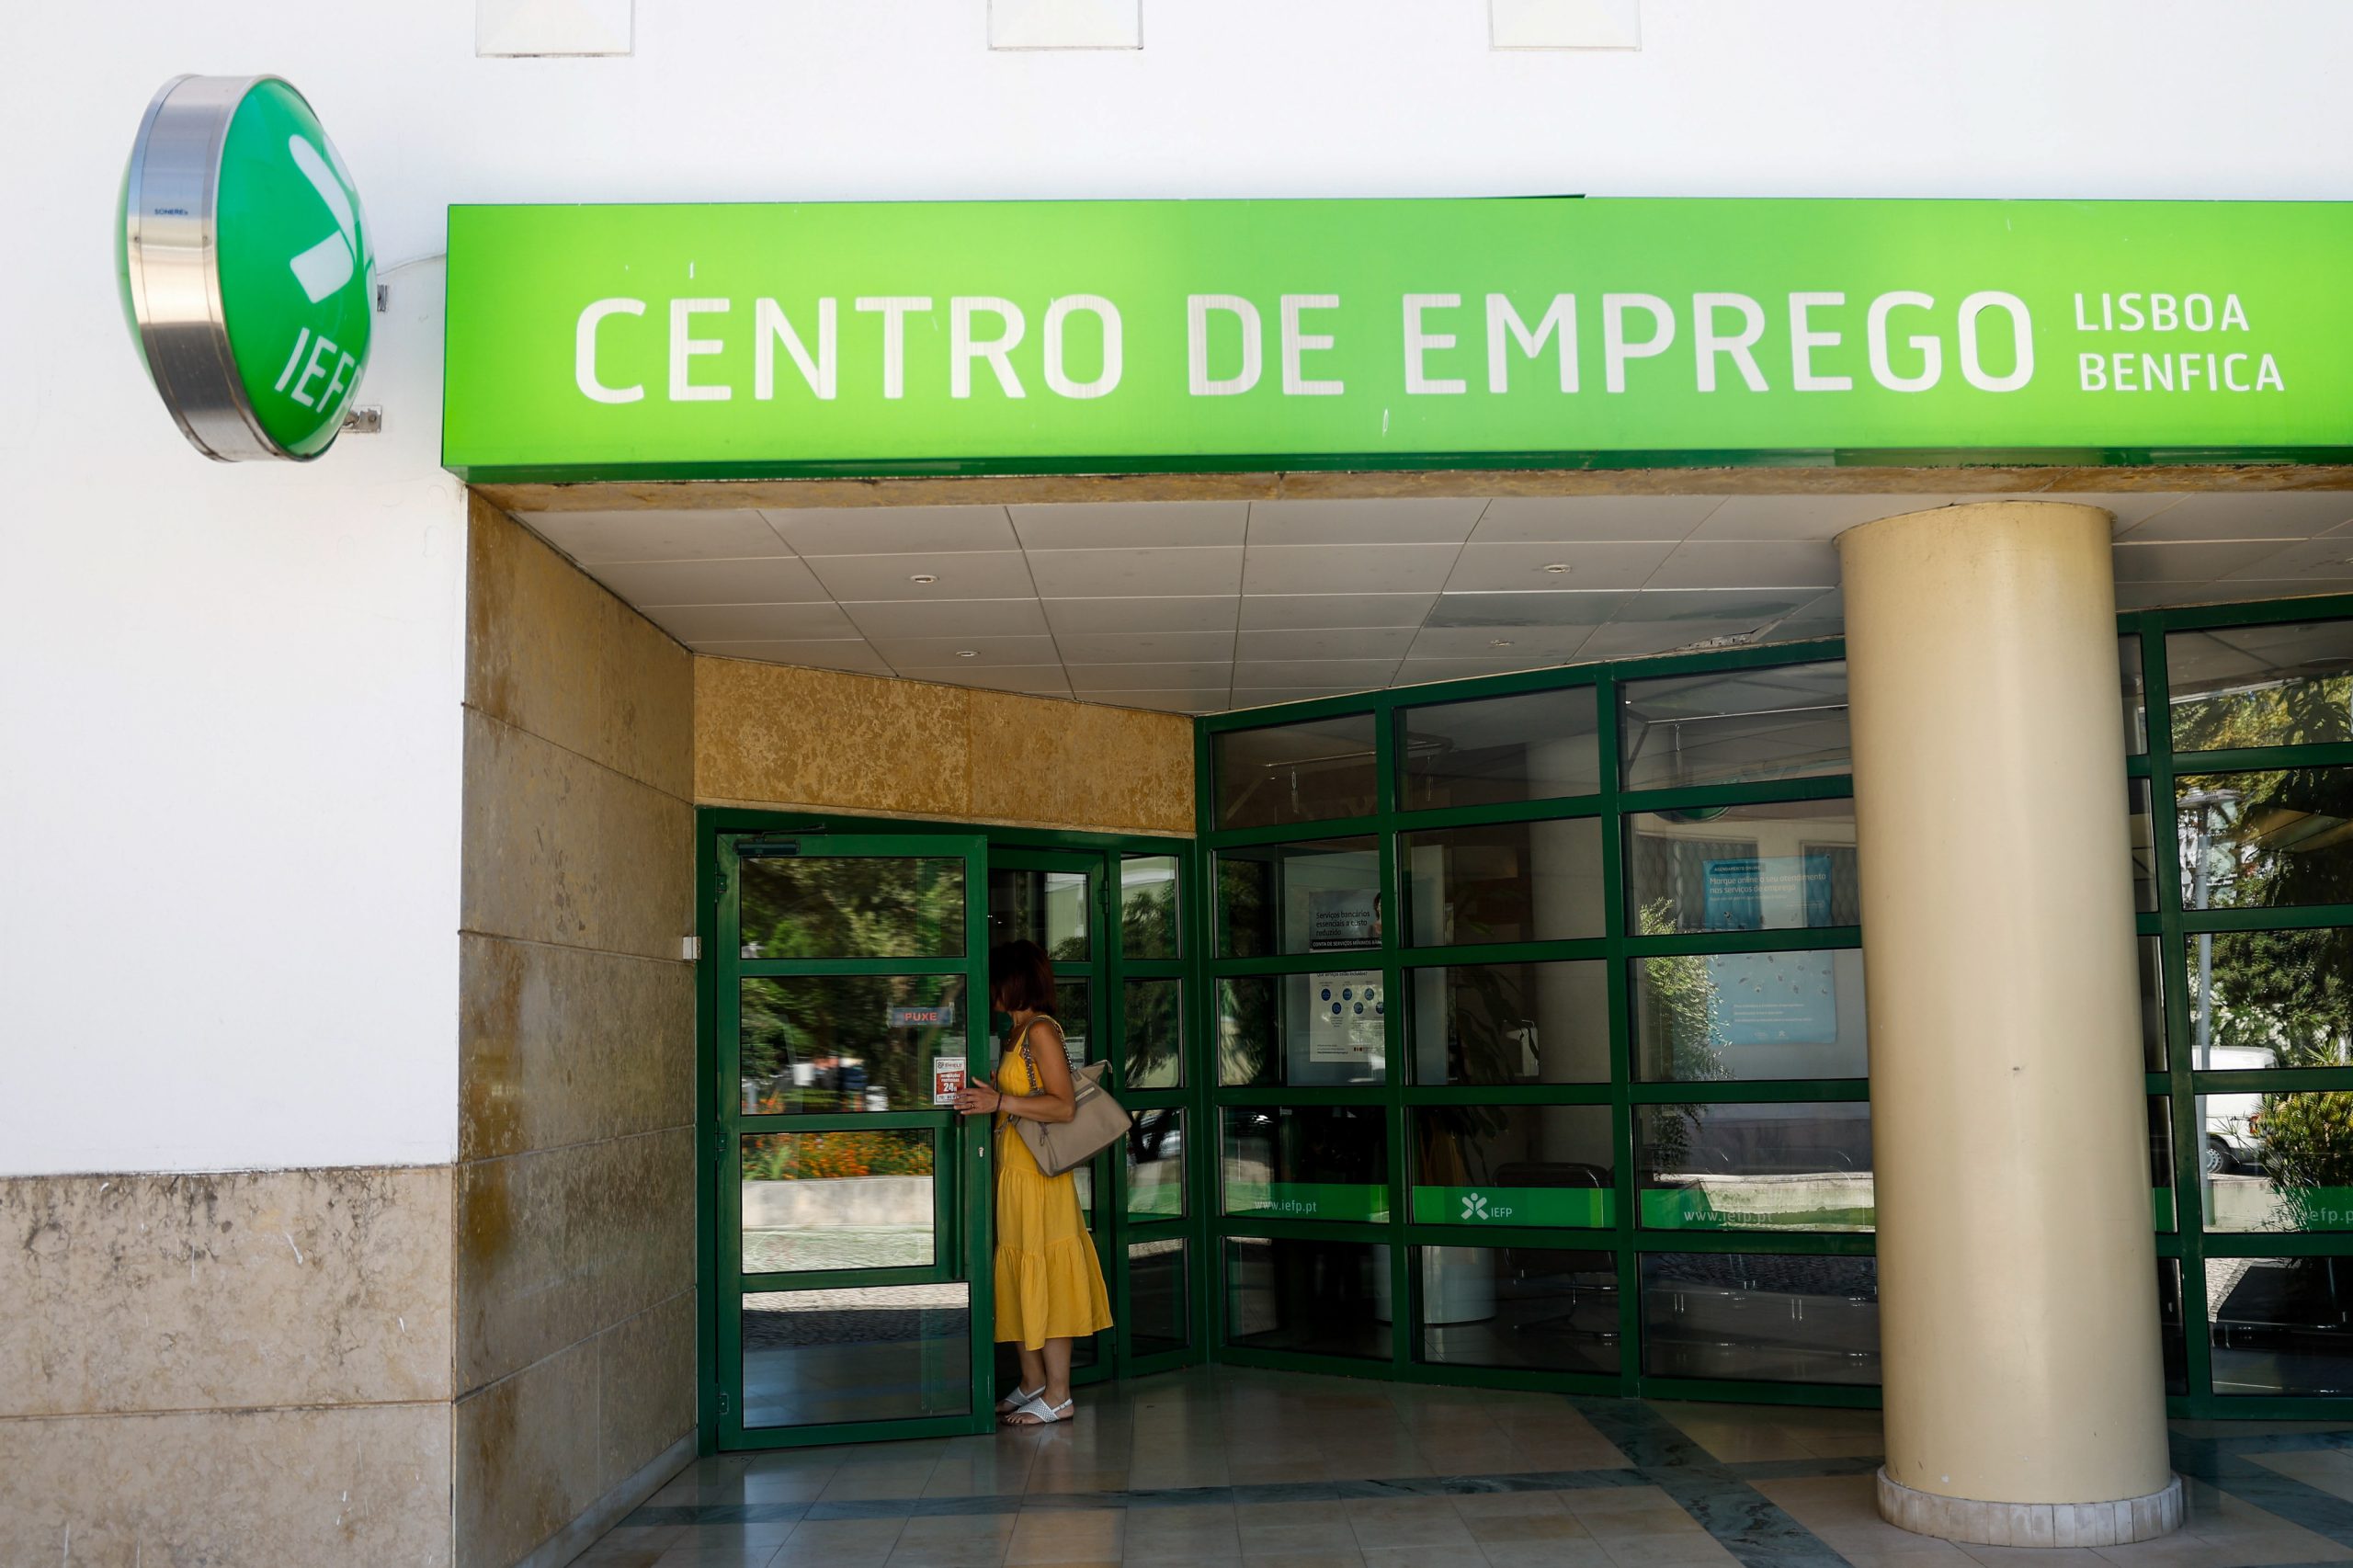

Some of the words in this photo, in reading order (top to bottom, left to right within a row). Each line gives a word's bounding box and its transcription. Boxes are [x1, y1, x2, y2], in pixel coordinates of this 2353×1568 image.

[2074, 292, 2250, 332] LISBOA
[575, 293, 1123, 403] CENTRO
[1187, 293, 1345, 396] DE
[1402, 290, 2035, 395] EMPREGO
[2079, 352, 2285, 392] BENFICA
[1710, 878, 1736, 886] Marque
[1737, 876, 1758, 884] online
[1315, 912, 1340, 920] Serviços
[1341, 910, 1370, 918] bancários
[1315, 920, 1345, 928] essenciais
[1315, 928, 1342, 937] reduzido
[904, 1012, 938, 1021] PUXE
[1255, 1199, 1317, 1214] www.iefp.pt
[1491, 1207, 1513, 1218] IEFP
